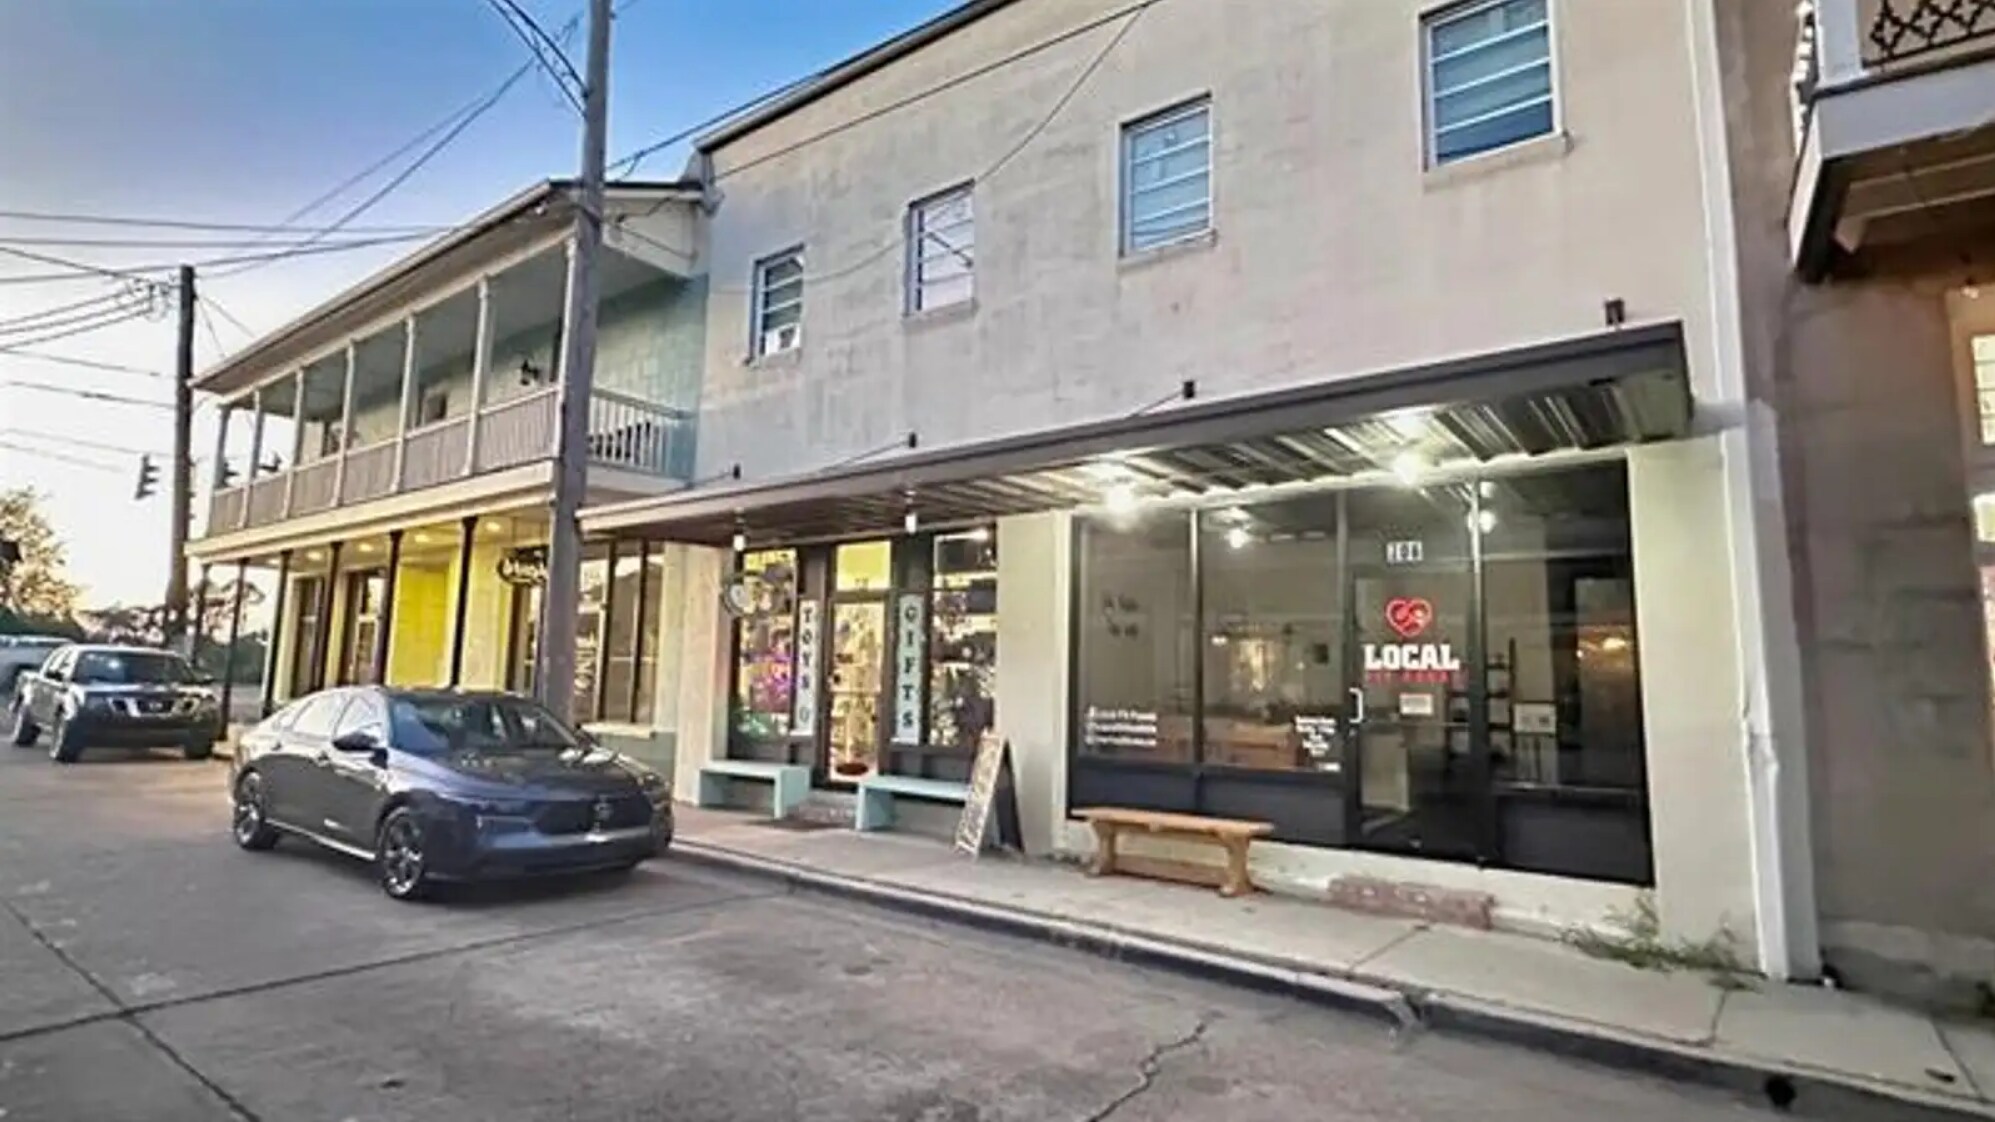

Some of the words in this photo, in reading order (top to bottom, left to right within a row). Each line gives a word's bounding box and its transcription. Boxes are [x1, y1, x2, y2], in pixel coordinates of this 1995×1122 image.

[801, 606, 815, 690] TOYS
[902, 604, 917, 729] GIFTS
[1362, 643, 1460, 671] LOCAL
